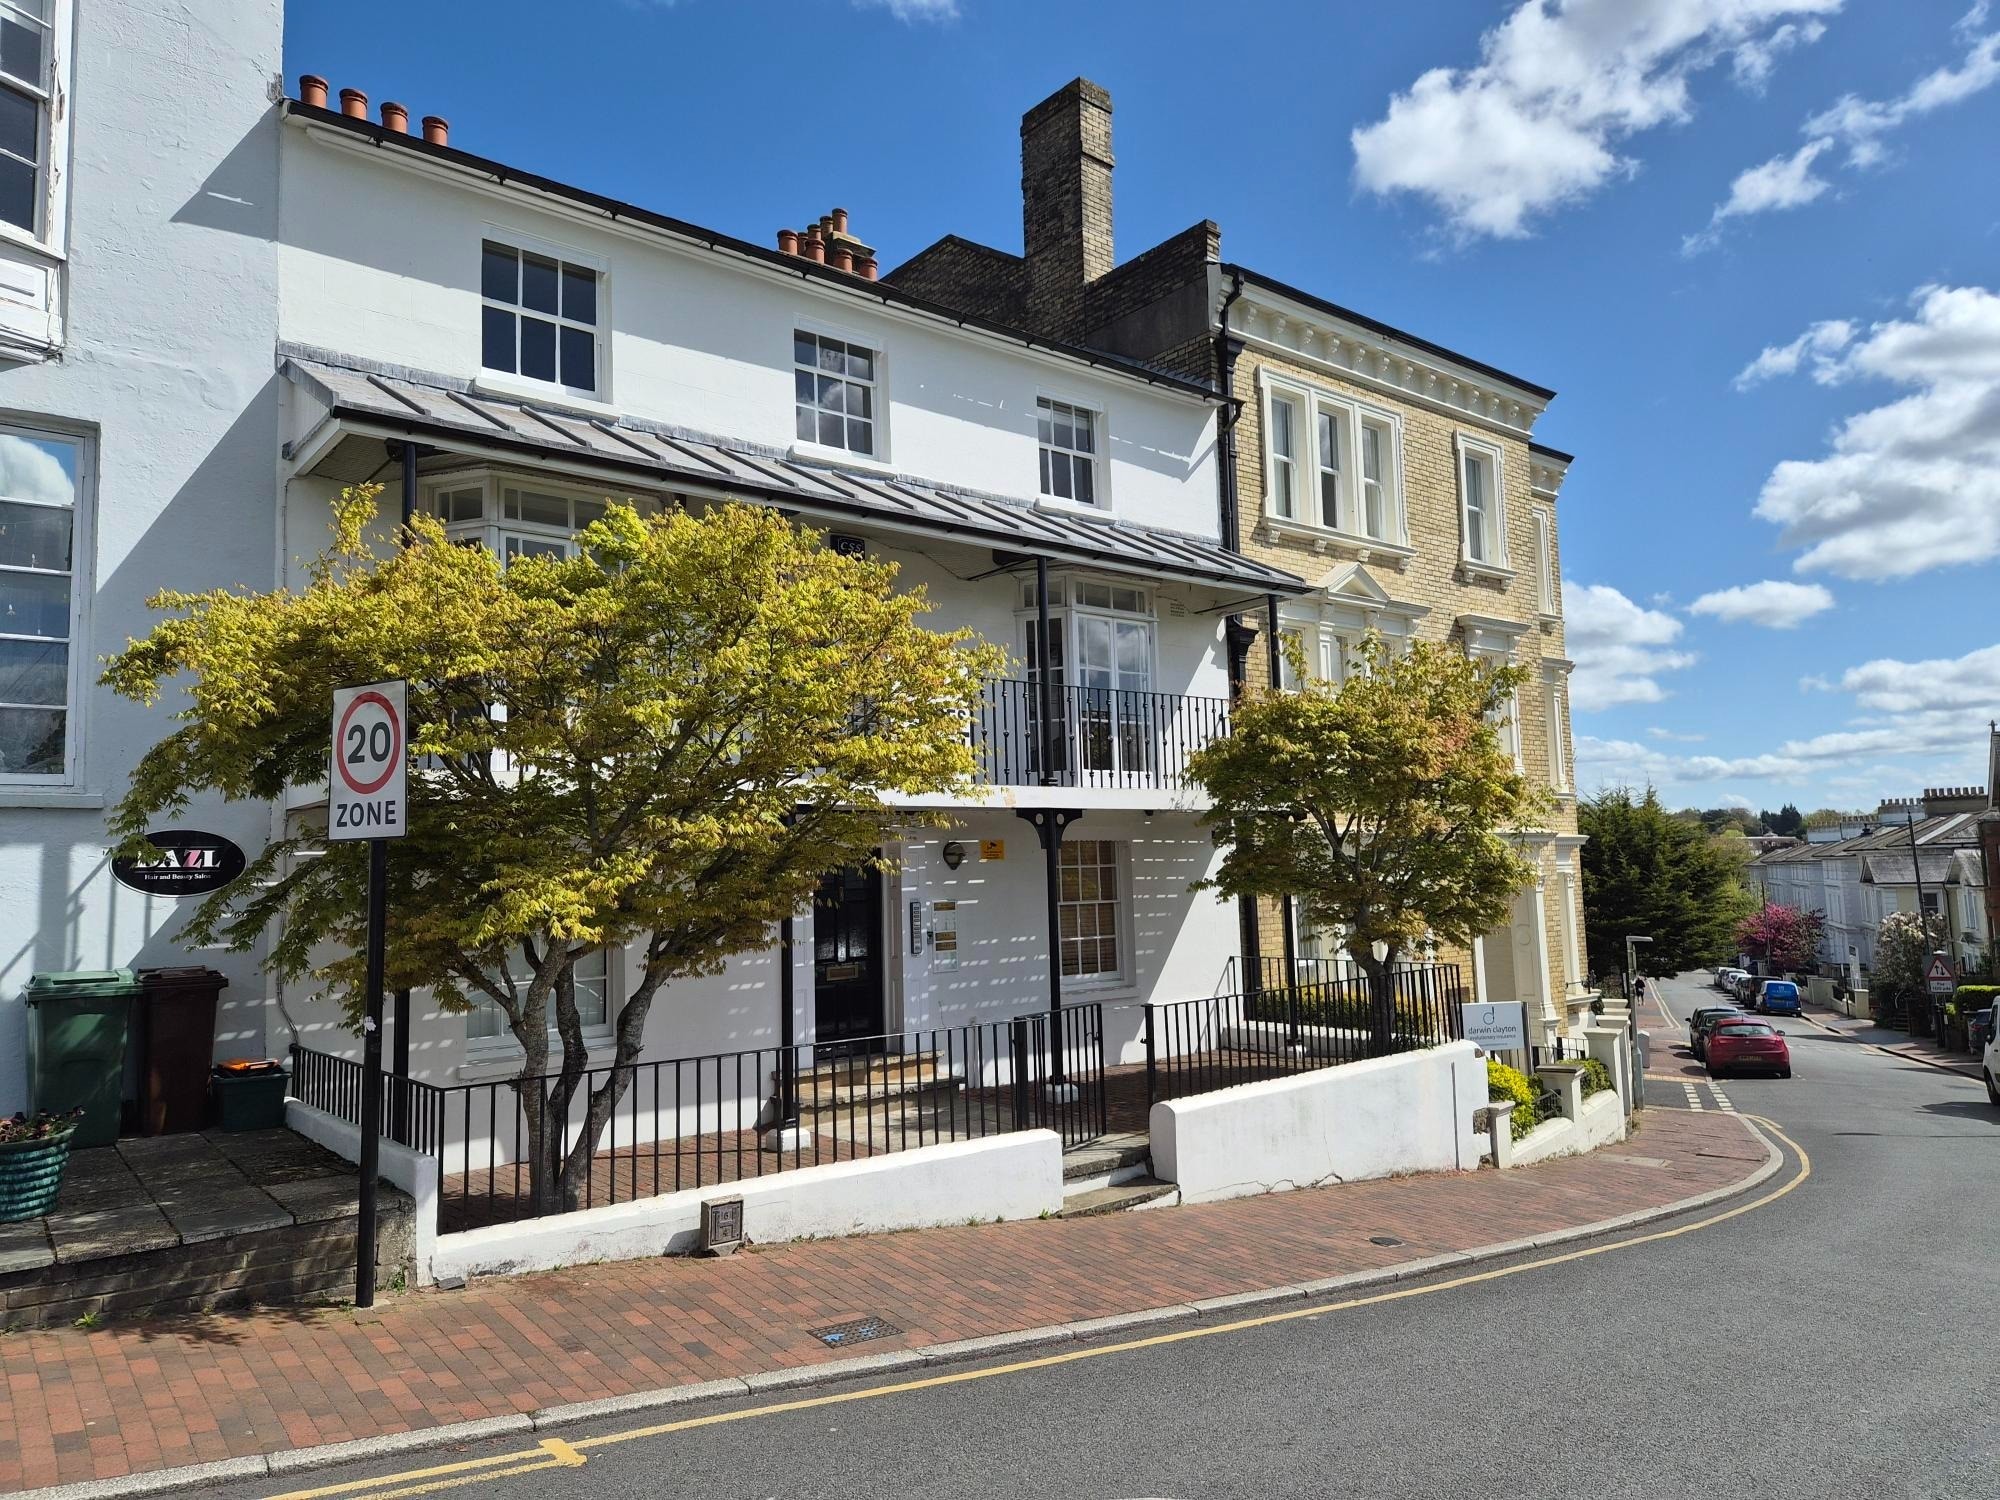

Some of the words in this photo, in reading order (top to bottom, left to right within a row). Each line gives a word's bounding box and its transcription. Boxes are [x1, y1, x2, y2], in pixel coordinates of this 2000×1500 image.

[347, 722, 390, 764] 20
[336, 800, 397, 827] ZONE
[1468, 1025, 1492, 1035] darwin
[1492, 1025, 1517, 1034] clayton
